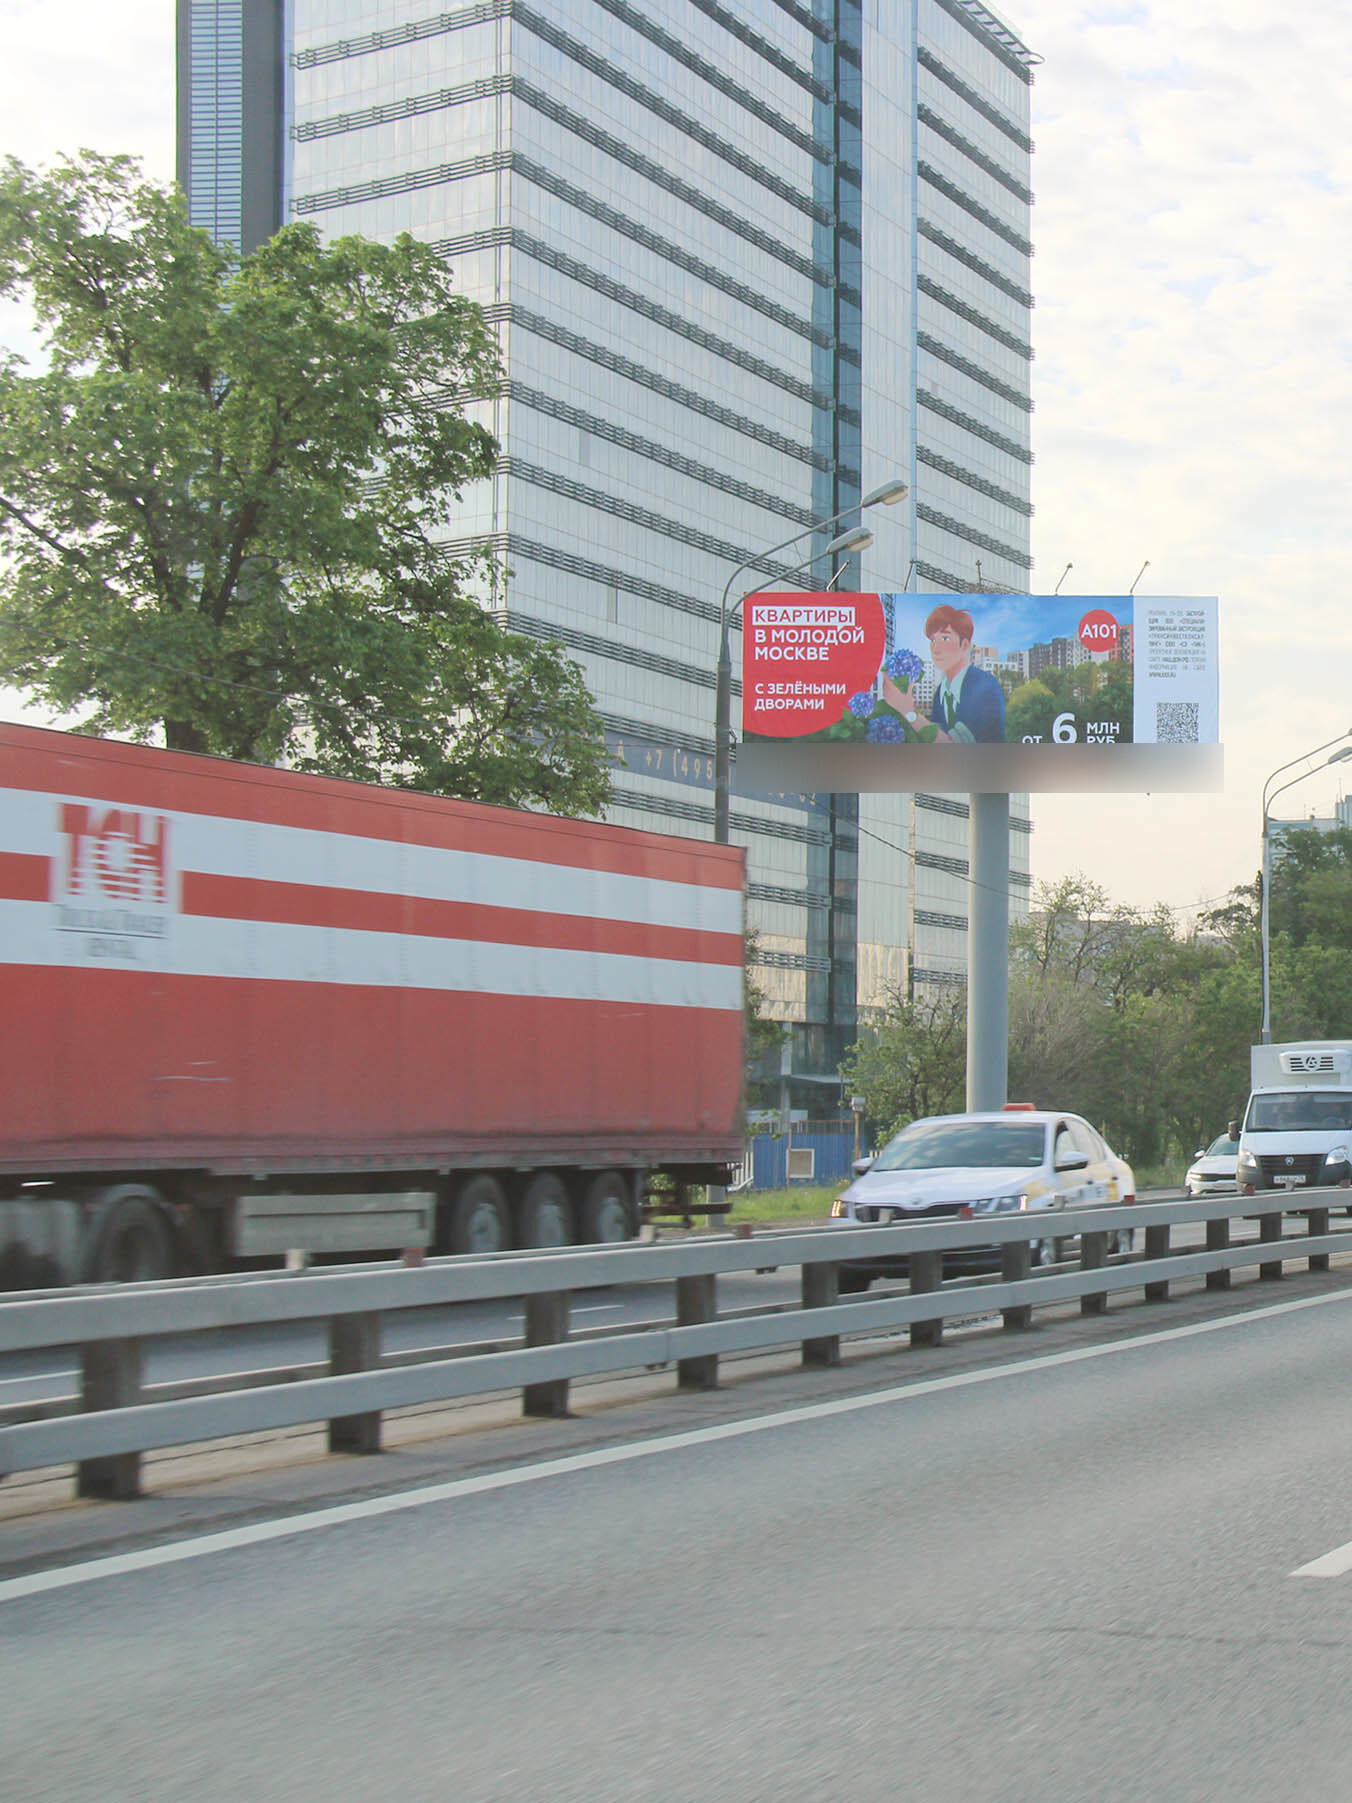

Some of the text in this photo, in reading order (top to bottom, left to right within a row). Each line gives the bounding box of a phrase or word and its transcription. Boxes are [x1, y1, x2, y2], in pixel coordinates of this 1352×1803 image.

[754, 609, 853, 623] КВАРТИРЫ
[754, 626, 865, 646] В МОЛОДОЙ
[754, 646, 830, 661] МОСКВЕ
[754, 680, 847, 695] С ЗЕЛЁНЫМИ
[754, 698, 825, 711] ДВОРАМИ
[1052, 712, 1078, 743] 6
[1086, 722, 1121, 734] МЛН
